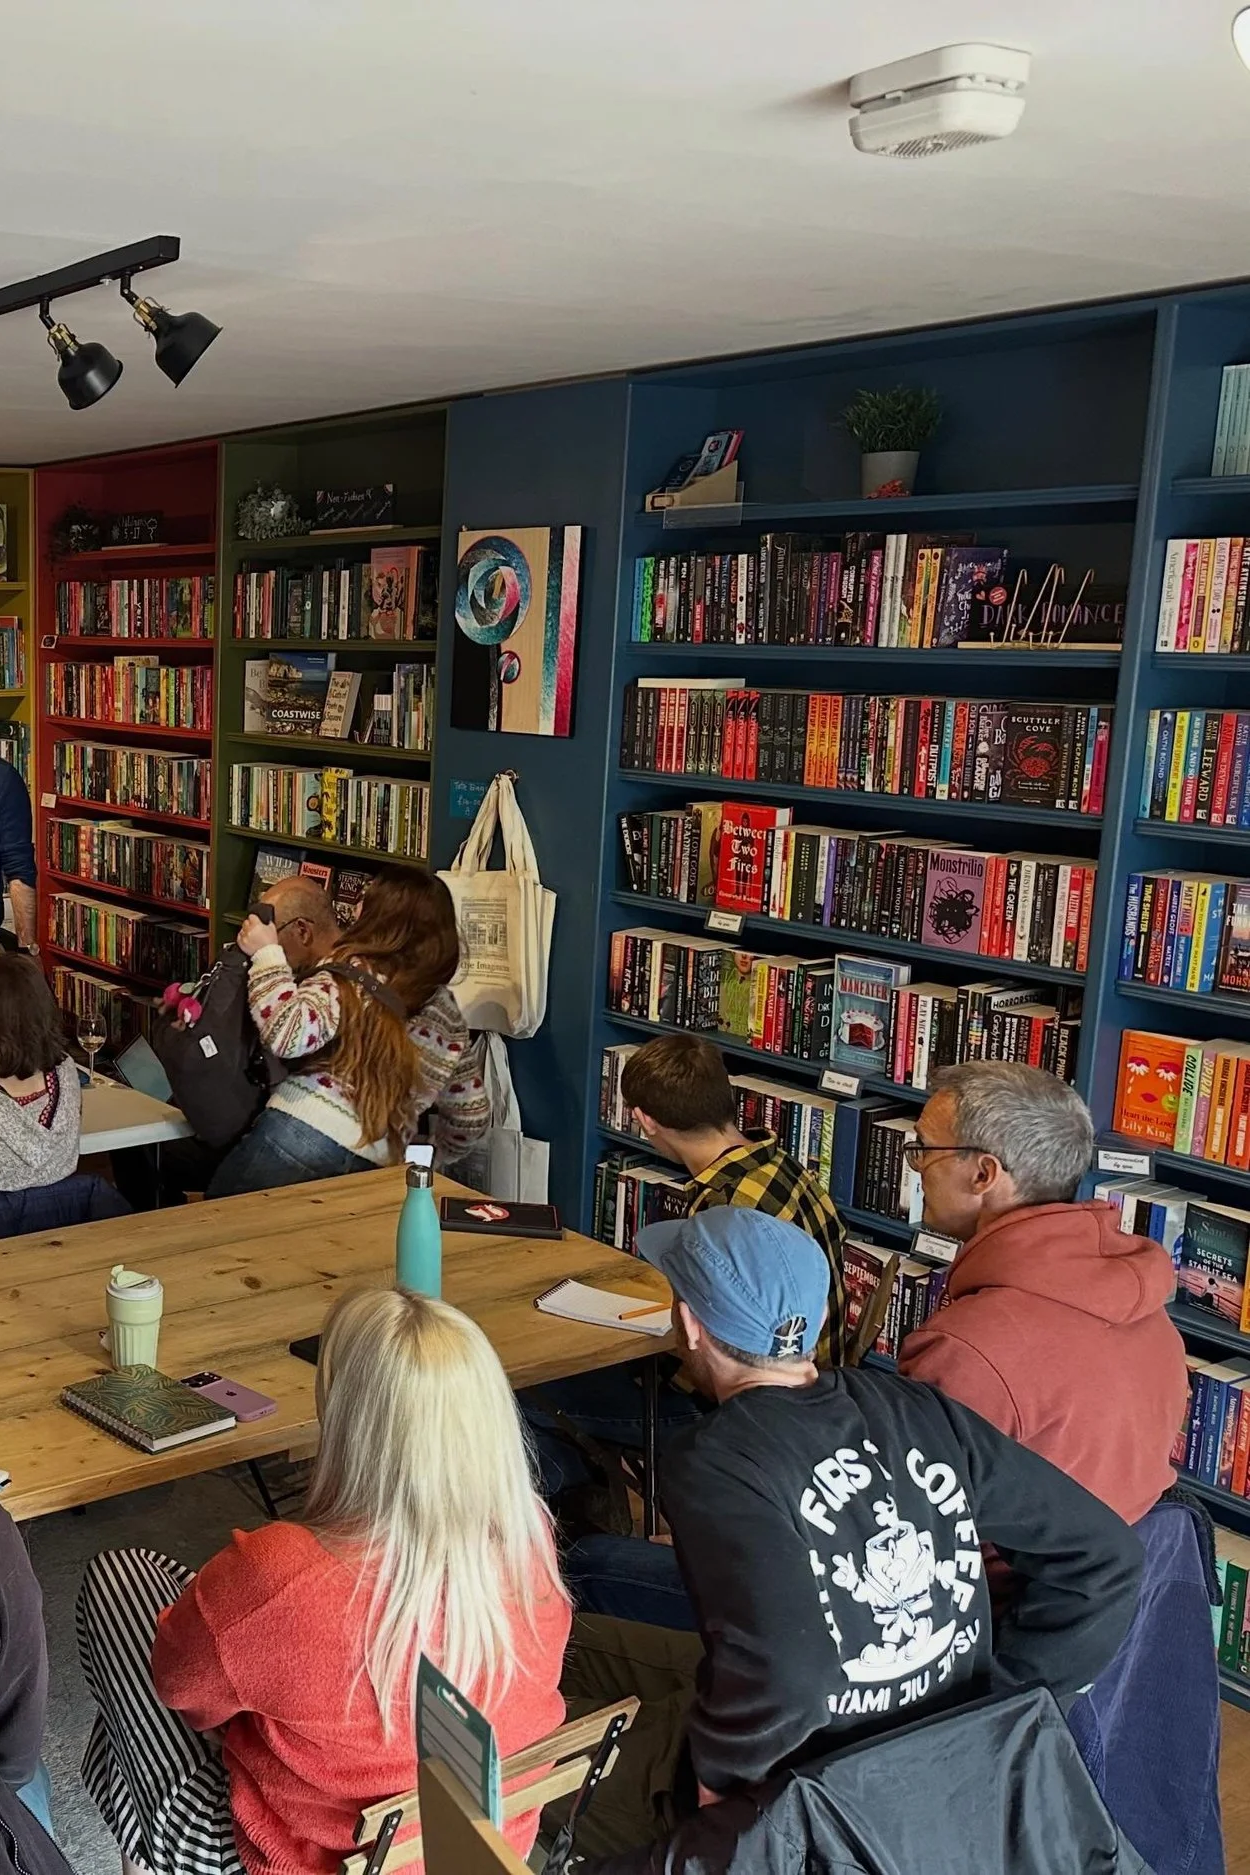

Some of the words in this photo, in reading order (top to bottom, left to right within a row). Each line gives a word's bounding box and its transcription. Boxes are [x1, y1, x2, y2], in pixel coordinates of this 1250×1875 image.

[1231, 546, 1240, 568] TASTING
[847, 566, 855, 603] CORRUPTED
[1166, 552, 1179, 602] Americanah
[1199, 564, 1207, 593] ALDERTON
[1238, 568, 1249, 606] ATKINSON
[1213, 589, 1222, 601] DAY
[272, 710, 321, 719] COASTWISE
[1011, 717, 1060, 725] SCUTTLER
[1241, 725, 1249, 744] KATIE
[927, 745, 938, 787] OUTPOST
[973, 757, 982, 790] GAME
[1188, 768, 1195, 779] SO
[1198, 749, 1215, 801] LEEWARD
[1217, 765, 1226, 786] DEVIL
[1231, 759, 1241, 795] MERCIFUL
[1184, 783, 1193, 805] ROAR
[1229, 797, 1237, 809] SEA
[682, 816, 693, 865] KRAMPUS
[691, 837, 699, 857] LOST
[731, 840, 757, 857] Two
[727, 859, 758, 875] Fires
[930, 852, 983, 877] Monstrilio
[340, 883, 357, 892] KING
[1008, 878, 1016, 892] THE
[1023, 865, 1032, 902] CHRISTMAS
[1129, 884, 1137, 894] The
[1144, 884, 1153, 902] TIME
[1006, 894, 1015, 920] QUEEN
[1185, 886, 1194, 906] MATT
[1067, 890, 1081, 928] HAZELTHORN
[1125, 896, 1138, 936] HUSBANDS
[1140, 904, 1150, 932] SHELTER
[1182, 909, 1191, 926] HAIG
[1233, 903, 1247, 914] THE
[1168, 914, 1176, 935] GROFF
[841, 977, 887, 1000] MANEATER
[1058, 1028, 1069, 1057] BLACK
[1183, 1055, 1196, 1096] COLLIDE
[1200, 1058, 1214, 1098] SPIRAL
[1120, 1108, 1140, 1121] Heart
[1142, 1114, 1155, 1124] the
[1157, 1116, 1176, 1129] Lover
[1122, 1118, 1144, 1135] Lily
[1146, 1125, 1172, 1141] King
[820, 1112, 834, 1158] STEPHEN
[1103, 1153, 1144, 1164] Recommended
[1196, 1248, 1233, 1267] SECRETS
[1213, 1260, 1224, 1270] THE
[844, 1260, 880, 1289] SEPTEMBER
[1189, 1259, 1220, 1277] STARLIT
[1222, 1271, 1238, 1284] SEA
[898, 1670, 930, 1706] JIU
